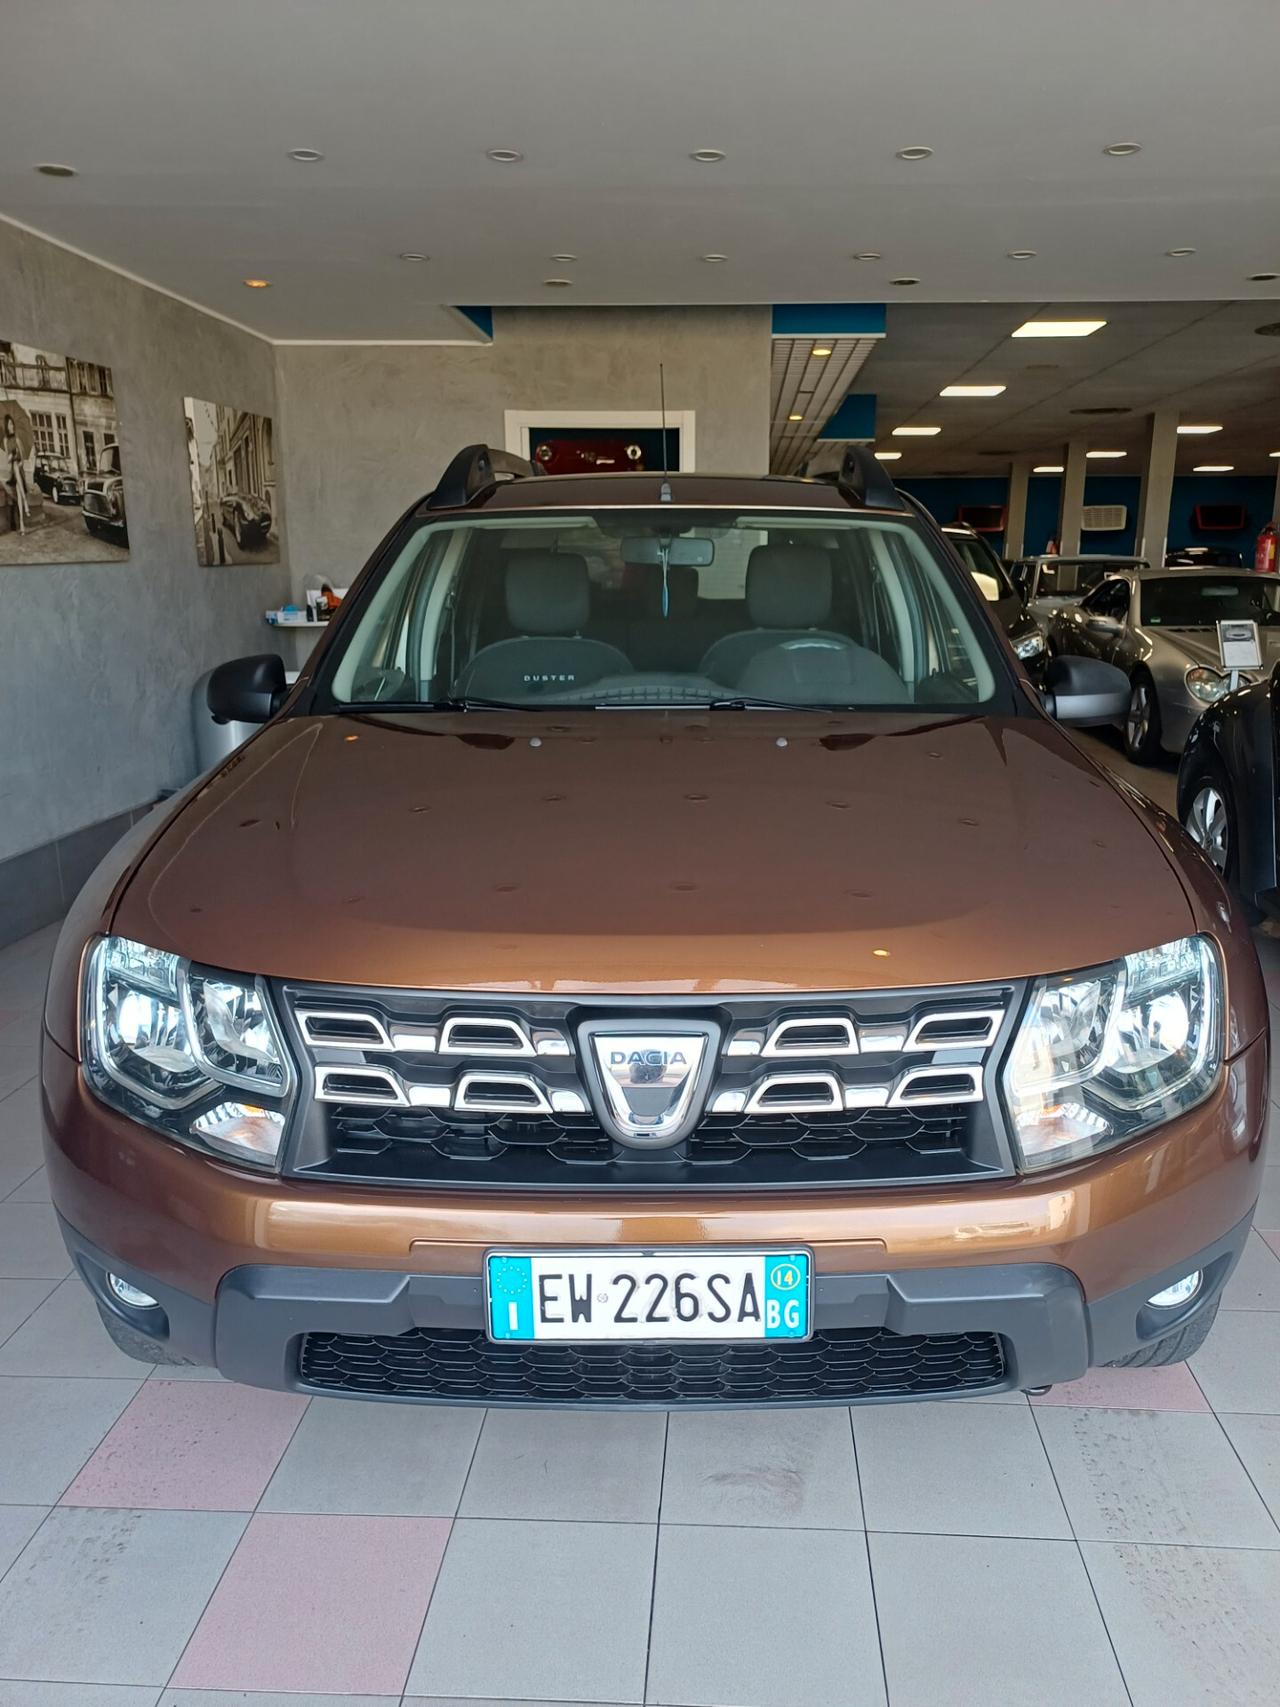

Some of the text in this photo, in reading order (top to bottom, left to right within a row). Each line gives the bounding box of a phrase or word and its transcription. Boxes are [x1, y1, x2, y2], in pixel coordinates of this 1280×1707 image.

[523, 674, 575, 682] DUSTER
[610, 1051, 687, 1065] DACIA
[775, 1269, 794, 1287] 14
[766, 1298, 800, 1329] BG
